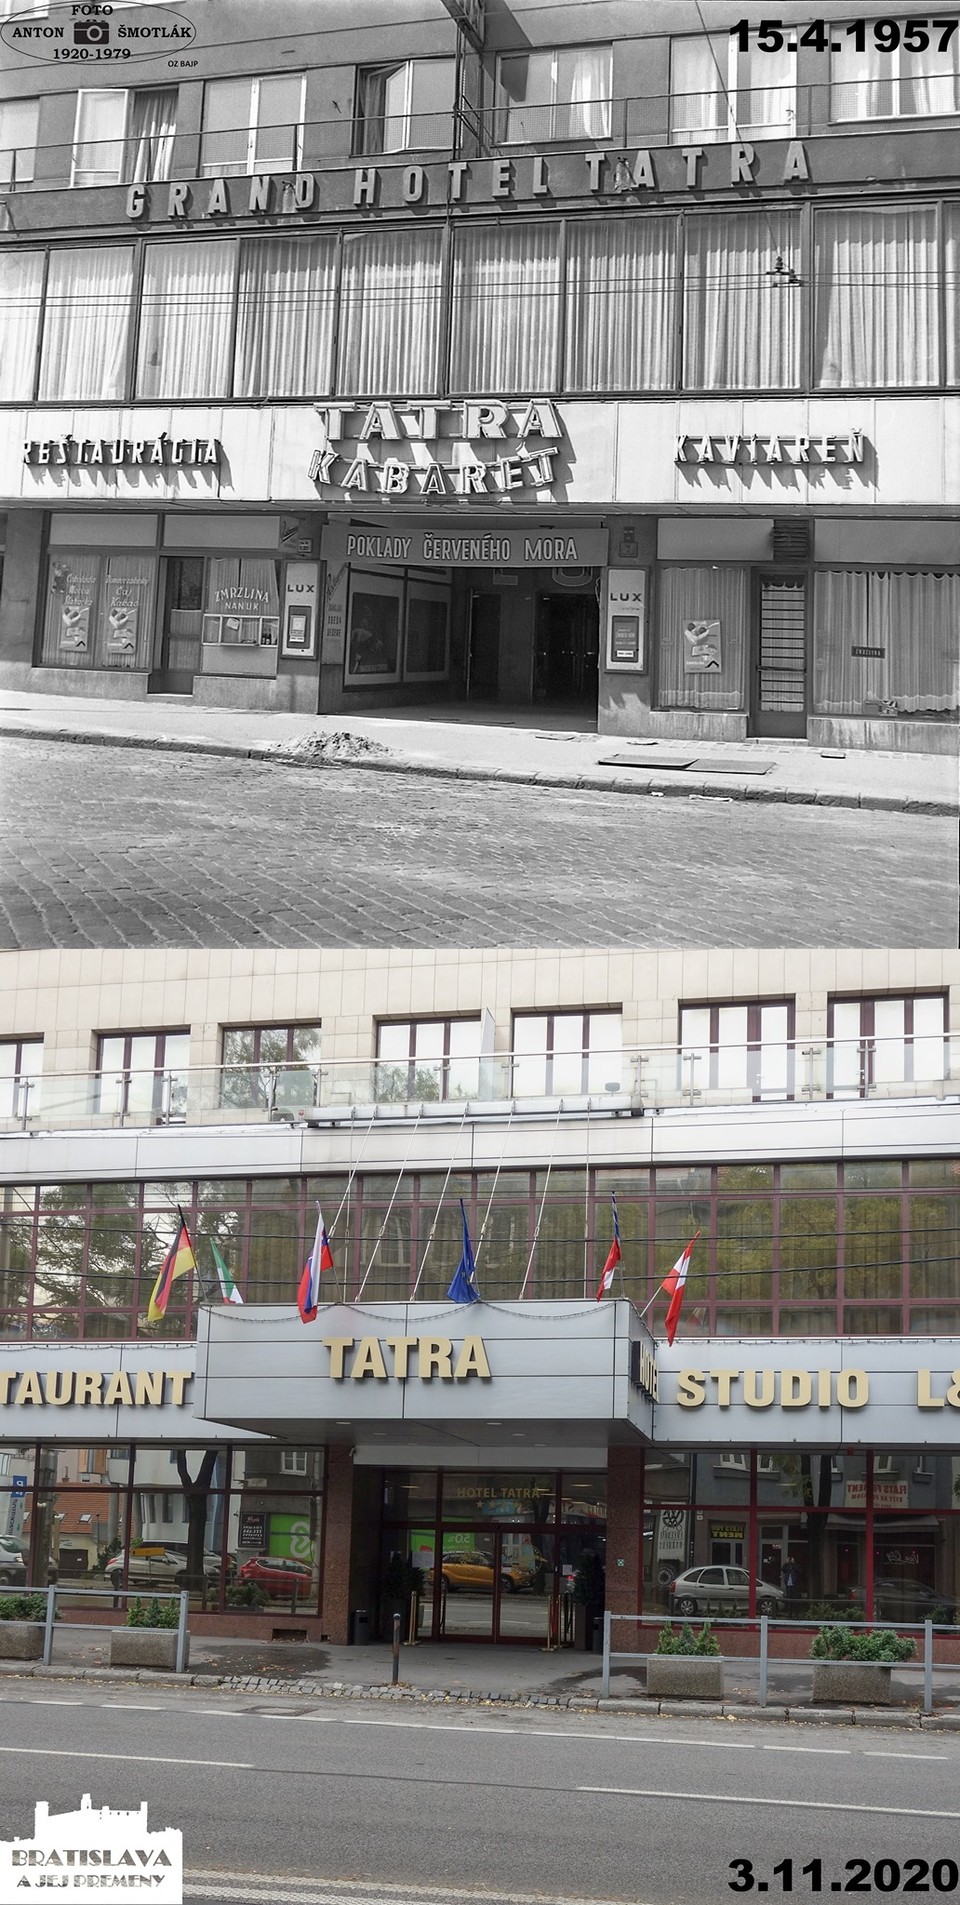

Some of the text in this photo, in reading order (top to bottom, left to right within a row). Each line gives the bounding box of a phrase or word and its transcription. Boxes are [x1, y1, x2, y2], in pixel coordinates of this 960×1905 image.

[126, 140, 812, 219] GRAND HOTEL TATRA
[313, 399, 563, 440] TATRA
[23, 432, 221, 464] REŠTAURÁCIA
[674, 428, 864, 463] KAVIAREŇ
[347, 532, 578, 561] POKLADY ČERVENÉHO MORA
[215, 586, 269, 602] ZMRZLINA
[287, 584, 314, 593] LUX
[610, 593, 641, 602] LUX
[225, 602, 259, 610] NANUK
[322, 1336, 492, 1379] TATRA
[0, 1371, 194, 1406] TAURANT
[677, 1368, 869, 1408] STUDIO
[457, 1487, 540, 1498] HOTEL TATRA
